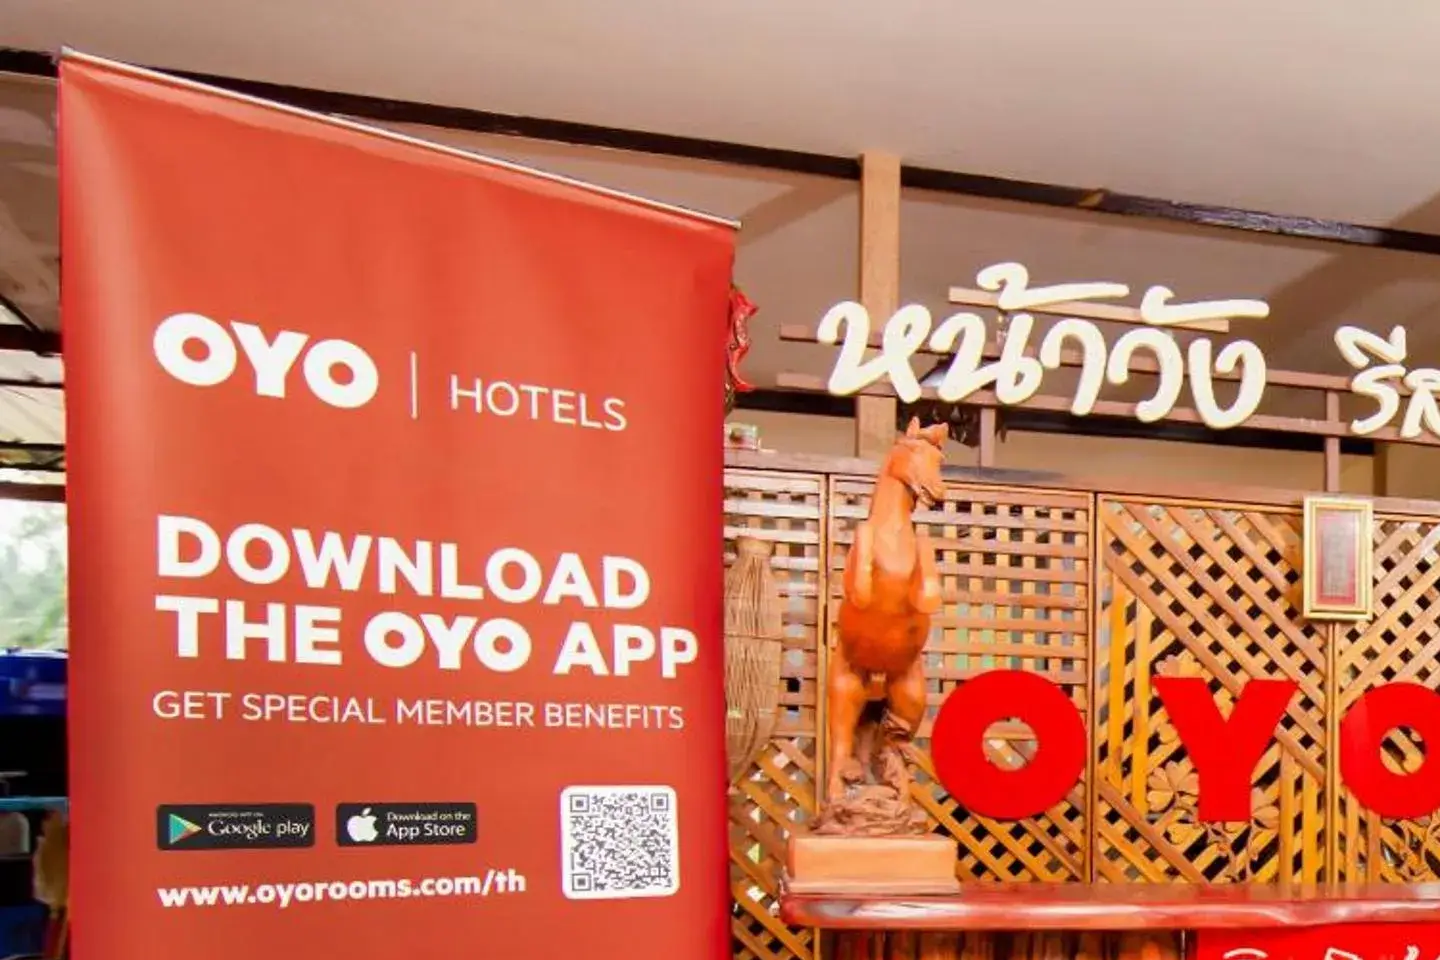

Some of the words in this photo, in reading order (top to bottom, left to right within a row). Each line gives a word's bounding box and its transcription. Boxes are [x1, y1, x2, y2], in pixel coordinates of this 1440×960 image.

[816, 261, 1271, 430] หน้าวัง
[152, 312, 380, 409] OYO
[451, 375, 627, 432] HOTELS
[157, 514, 651, 610] DOWNLOAD
[155, 596, 342, 666] THE
[363, 611, 532, 673] OYO
[552, 621, 698, 679] APP
[153, 690, 230, 720] GET
[242, 693, 385, 723] SPECIAL
[397, 698, 534, 727] MEMBER
[544, 702, 684, 730] BENEFITS
[207, 819, 272, 840] Google
[276, 820, 310, 838] play
[386, 823, 419, 840] App
[424, 823, 466, 837] Store
[387, 811, 438, 821] Download
[440, 813, 452, 821] on
[455, 812, 471, 821] the
[156, 869, 527, 909] www.oyorooms.com/th
